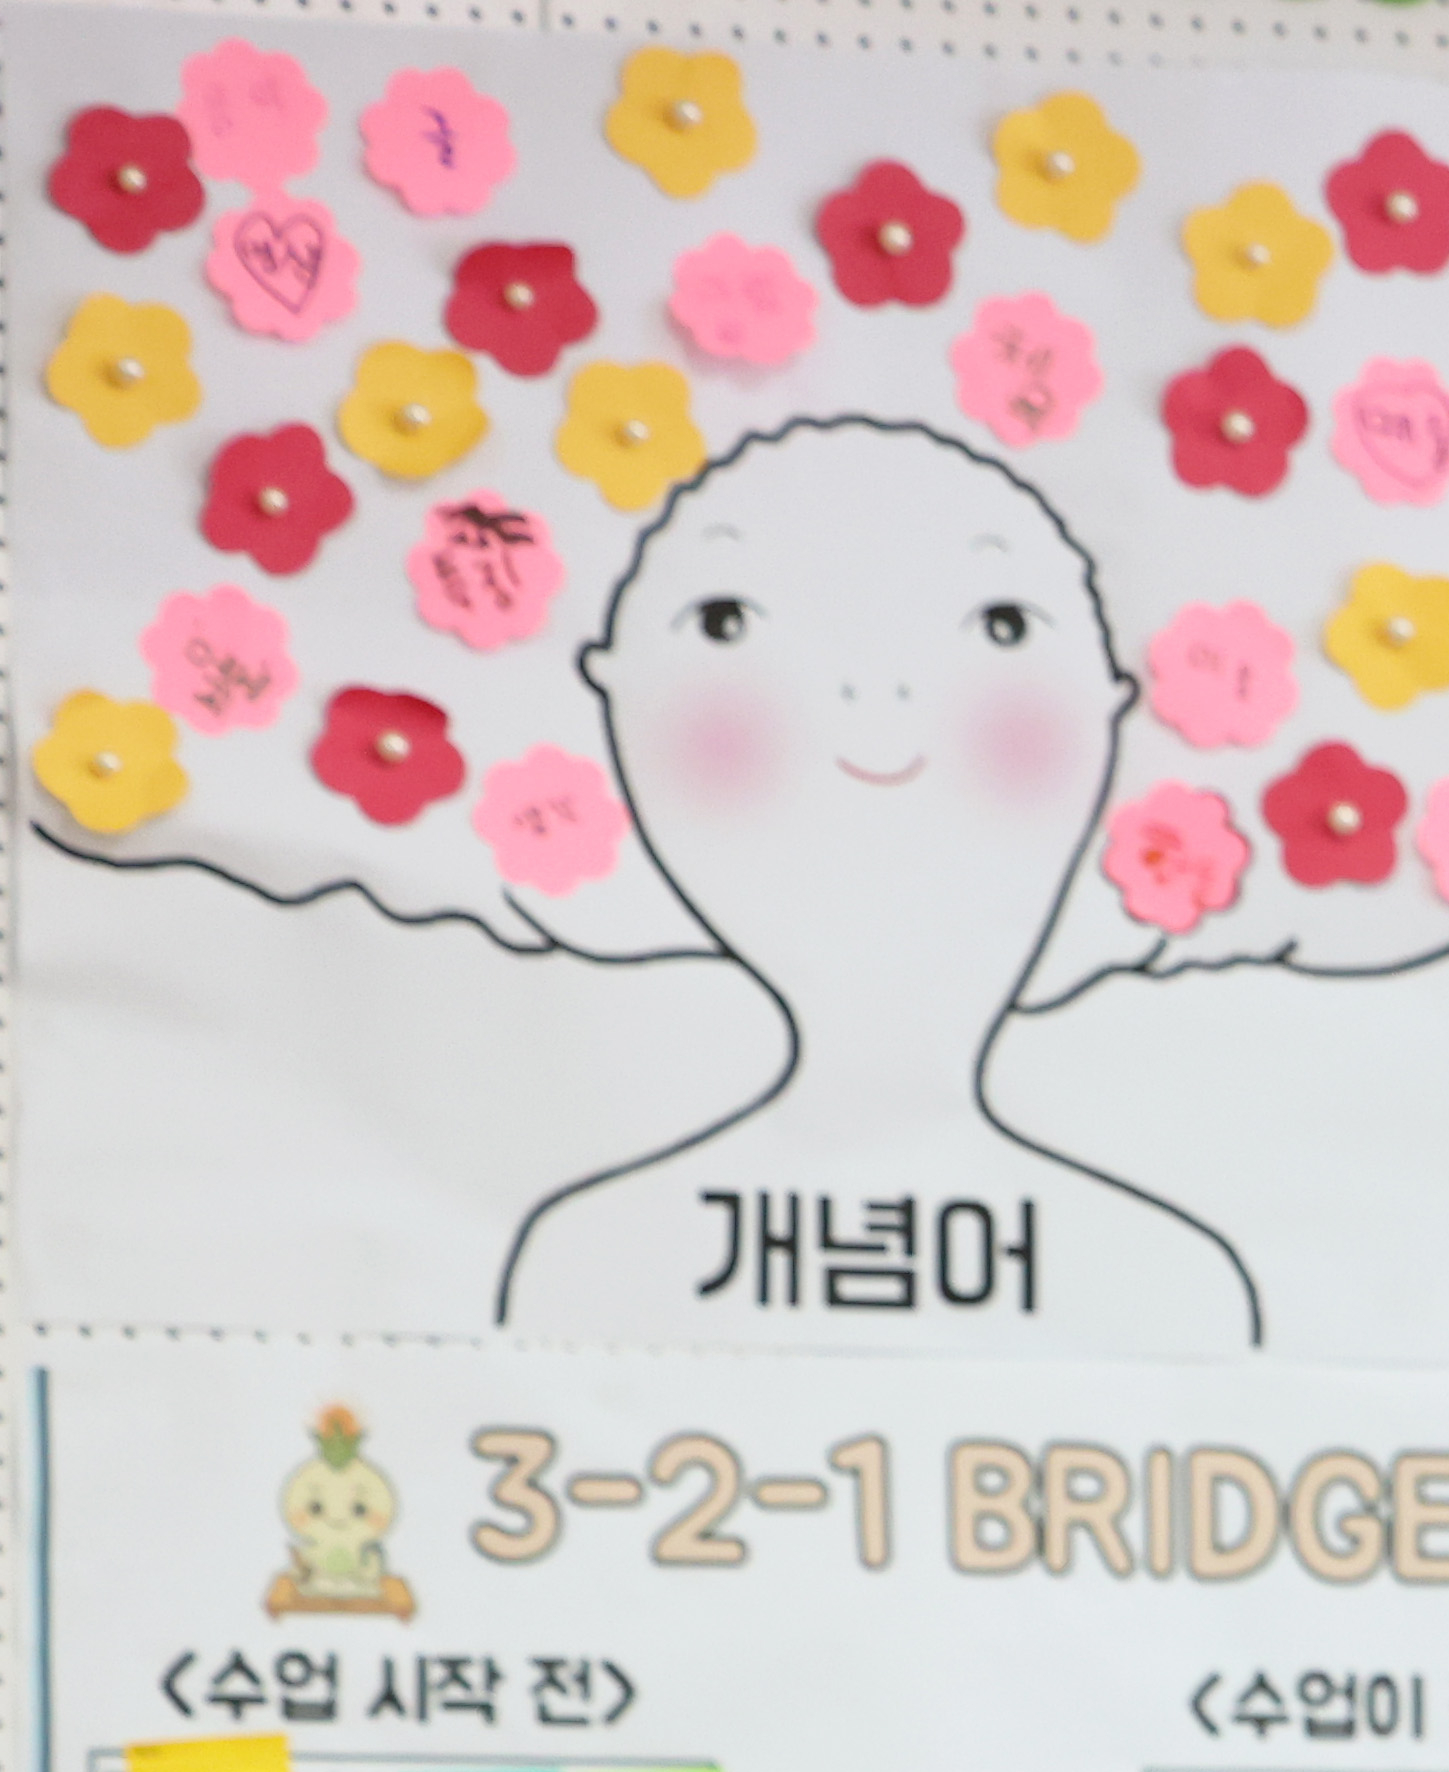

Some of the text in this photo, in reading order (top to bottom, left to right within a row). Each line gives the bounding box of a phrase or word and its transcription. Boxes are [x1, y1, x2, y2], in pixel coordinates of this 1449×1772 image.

[697, 1190, 1038, 1312] 개념어
[468, 1422, 894, 1571] 3-2-1
[369, 1654, 504, 1724] 시작
